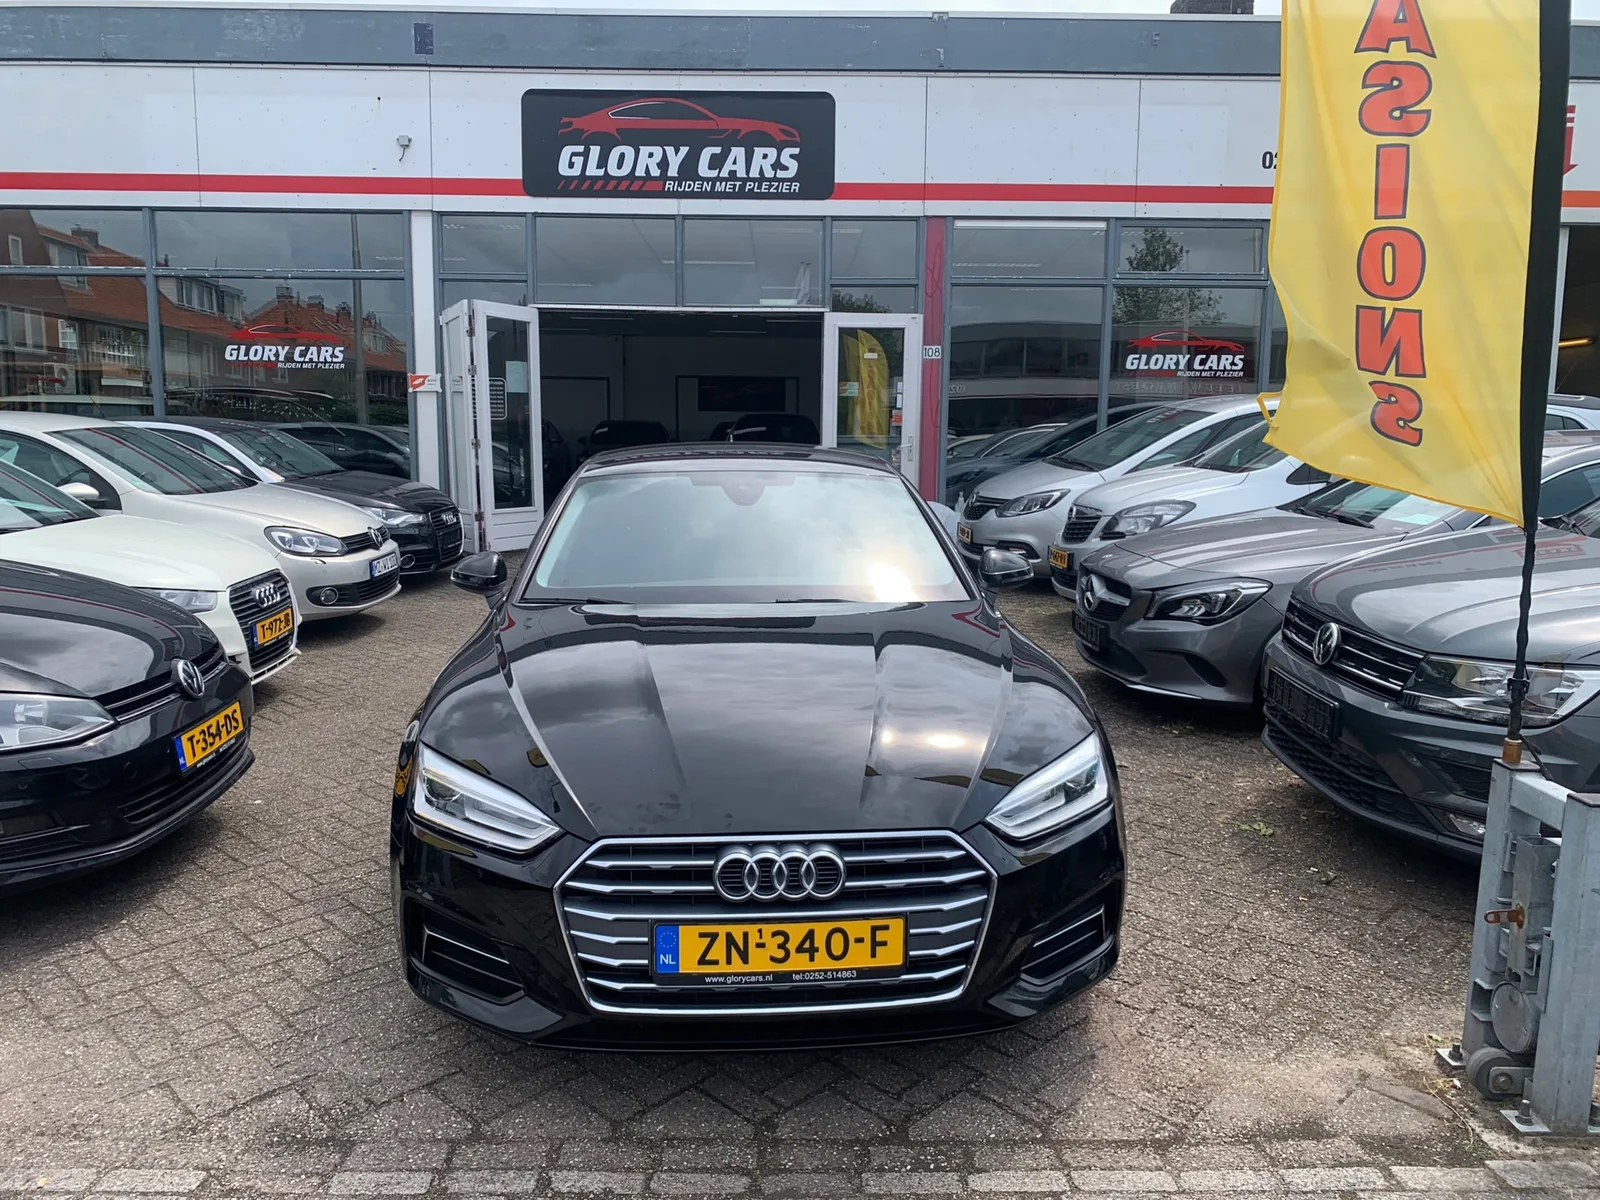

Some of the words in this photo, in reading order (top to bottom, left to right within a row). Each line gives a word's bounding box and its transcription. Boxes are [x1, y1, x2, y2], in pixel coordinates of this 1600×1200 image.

[558, 145, 690, 177] GLORY
[697, 146, 800, 178] CARS
[664, 181, 712, 192] RIJDEN
[714, 182, 742, 192] MET
[745, 182, 800, 193] PLEZIER
[224, 345, 290, 361] GLORY
[293, 346, 344, 362] CARS
[924, 347, 941, 358] 108
[1125, 354, 1191, 370] GLORY
[1193, 354, 1244, 370] CARS
[187, 708, 240, 759] T-354-DS
[659, 953, 676, 965] NL
[705, 973, 774, 984] www.glorycars.nl
[792, 970, 857, 981] tel:0252-514863
